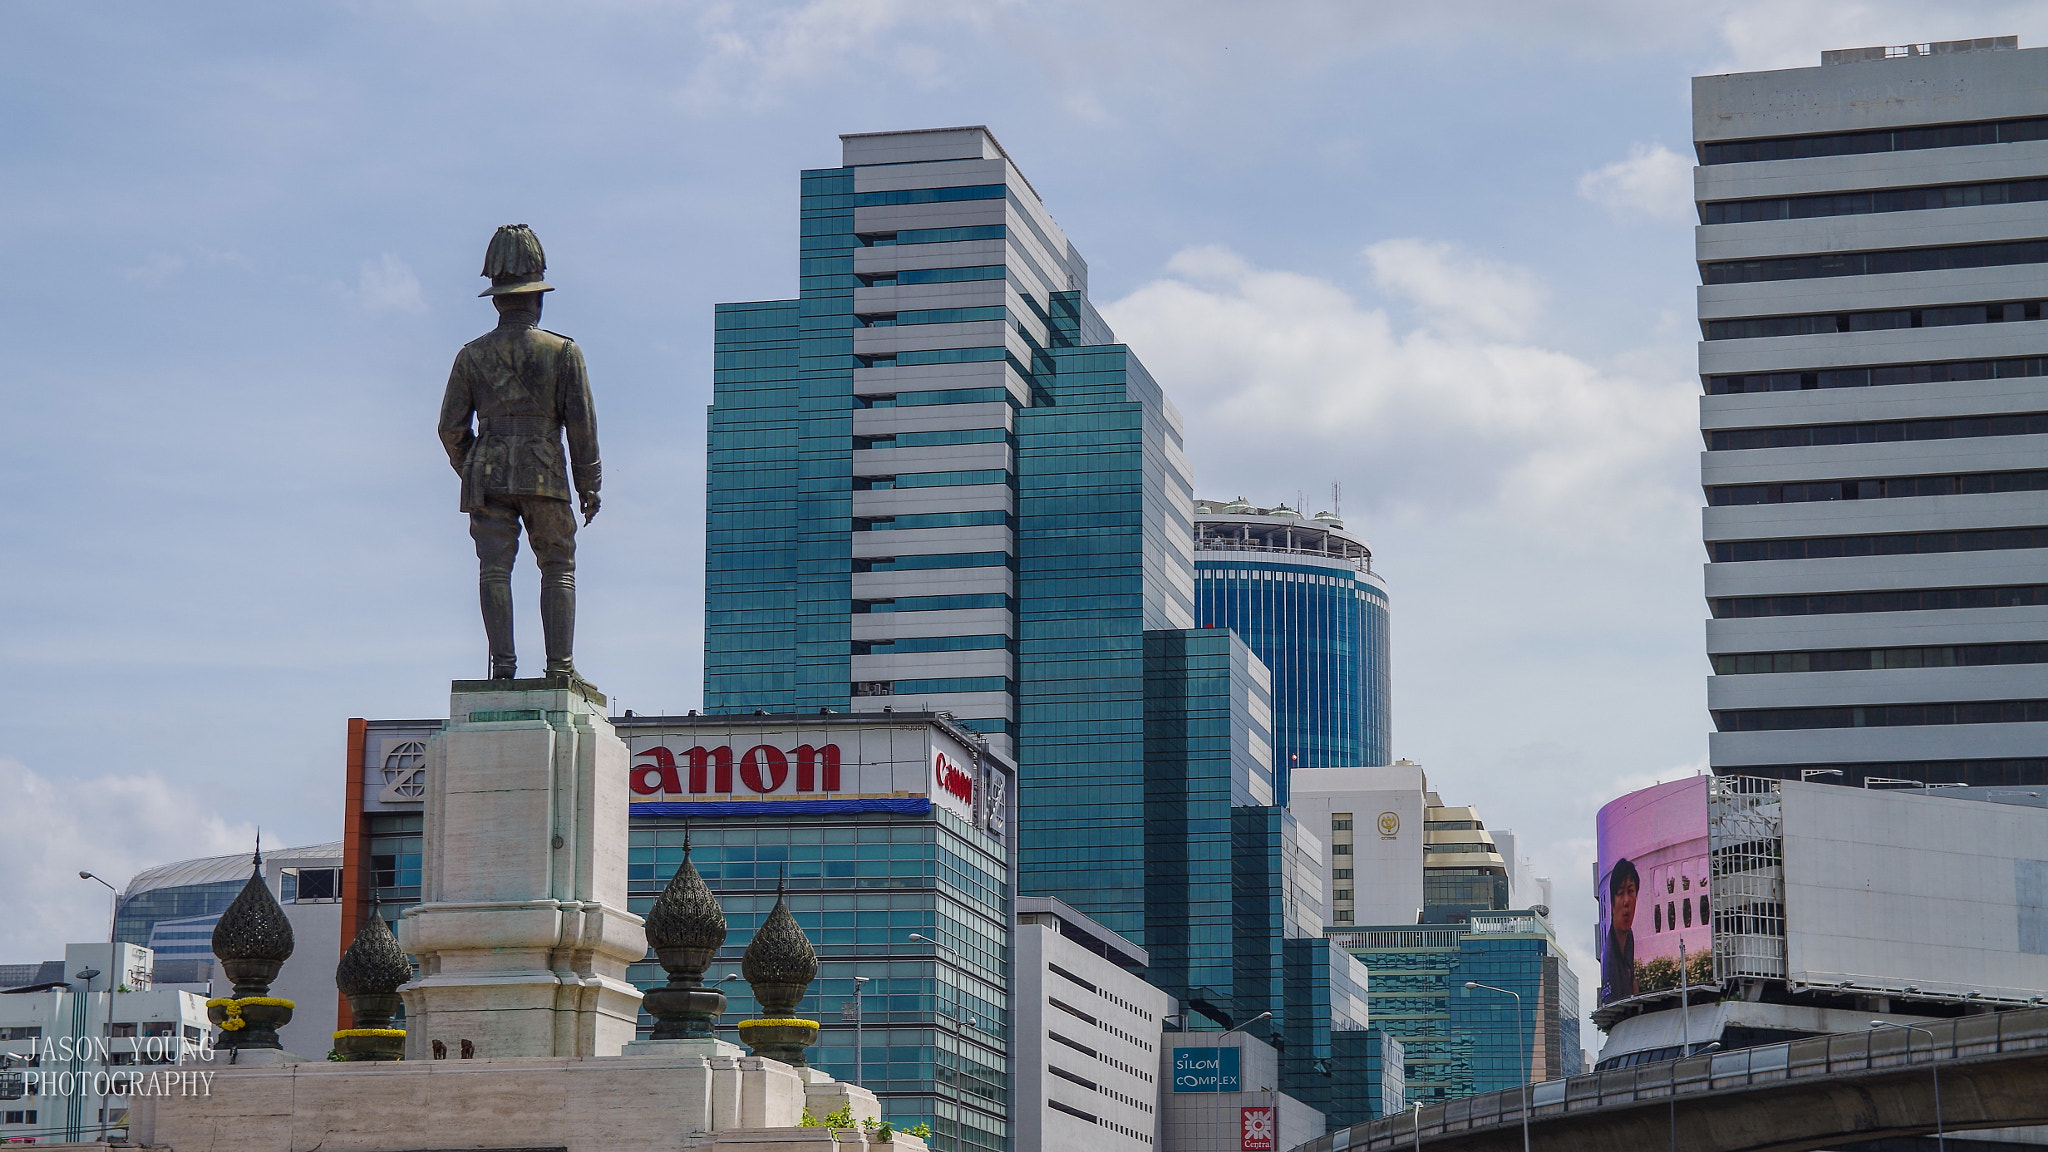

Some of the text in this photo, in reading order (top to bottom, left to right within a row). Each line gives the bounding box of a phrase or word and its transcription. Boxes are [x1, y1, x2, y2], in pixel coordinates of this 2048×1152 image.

[629, 743, 841, 795] anon
[936, 752, 973, 806] Canon
[1176, 1053, 1219, 1070] SILOM
